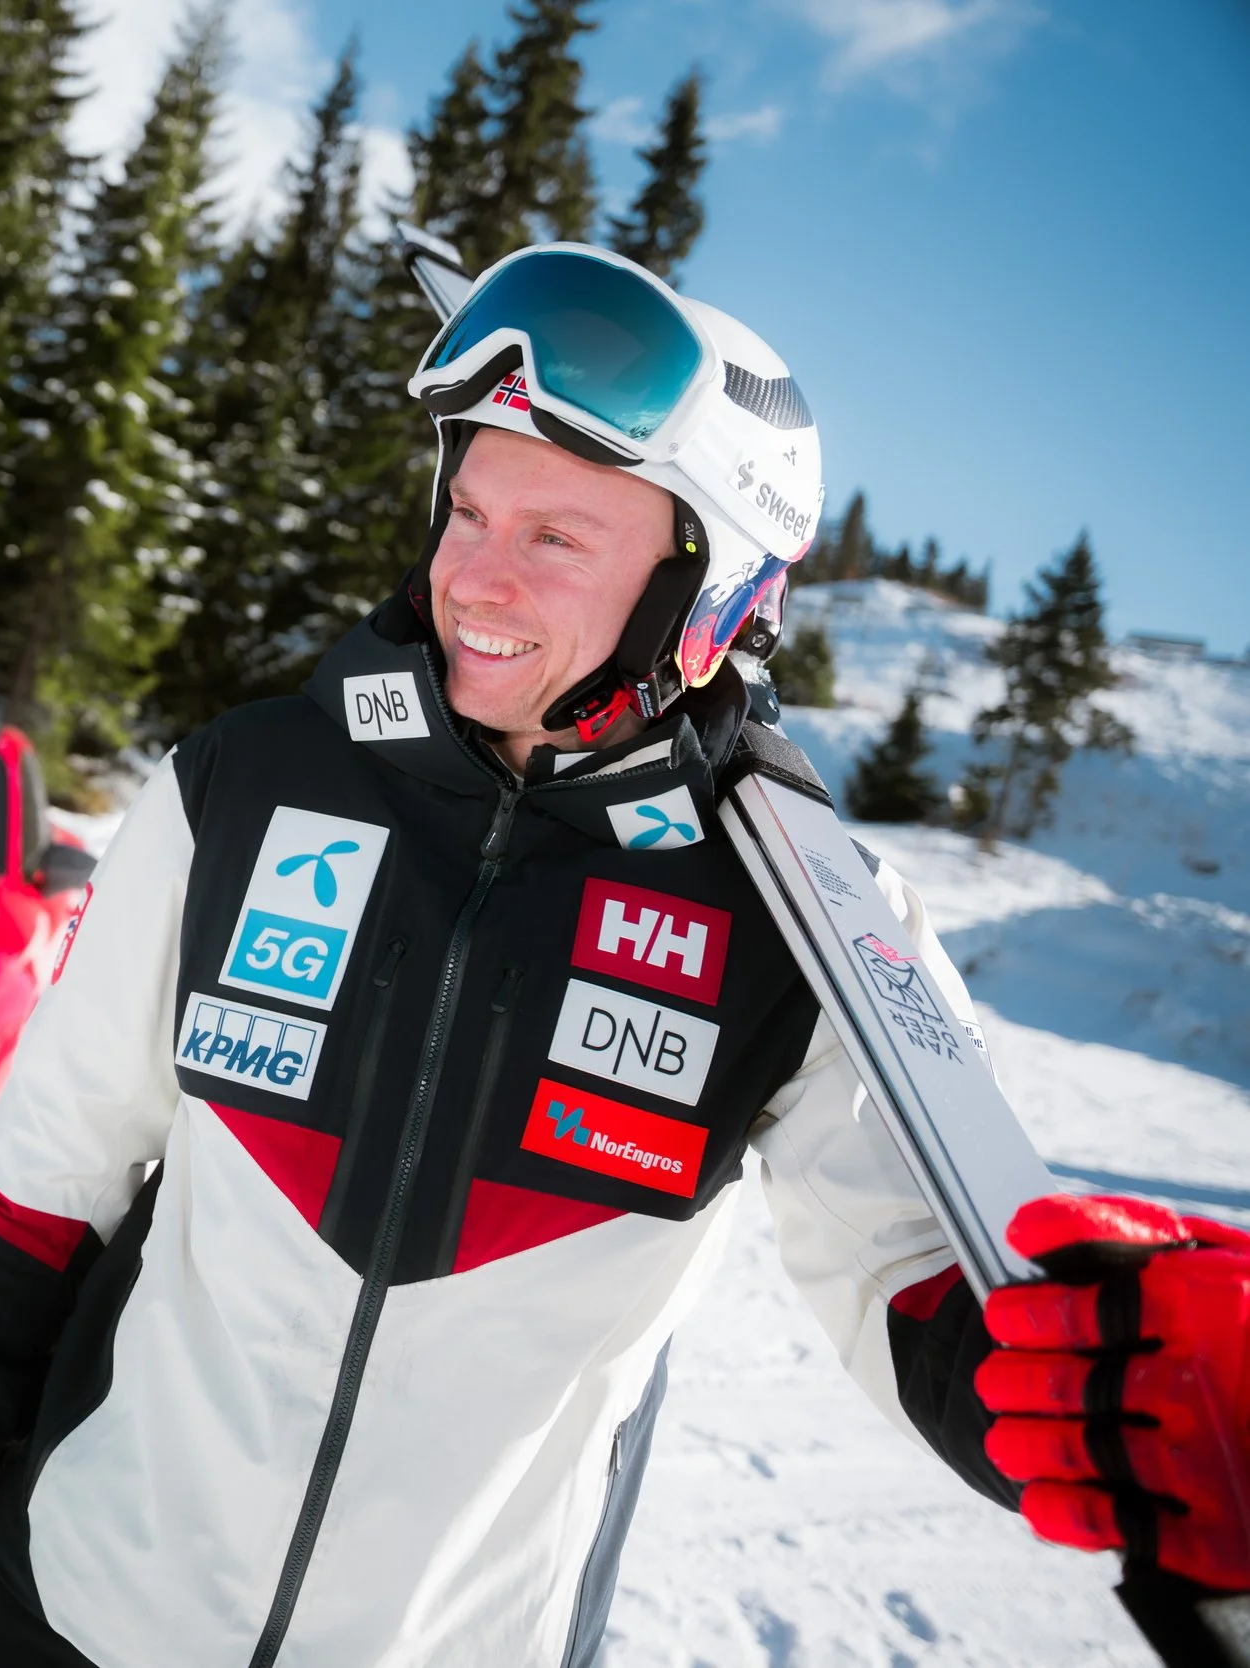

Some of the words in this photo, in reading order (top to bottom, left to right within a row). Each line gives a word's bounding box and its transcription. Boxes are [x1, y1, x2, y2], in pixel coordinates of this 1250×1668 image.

[356, 679, 408, 736] DNB
[246, 927, 328, 982] 5G
[597, 899, 708, 979] HH
[182, 1028, 303, 1086] KPMG
[582, 1010, 687, 1076] DNB
[888, 1008, 960, 1050] DEER
[906, 1030, 964, 1066] VAN
[590, 1132, 684, 1174] NorEngros
